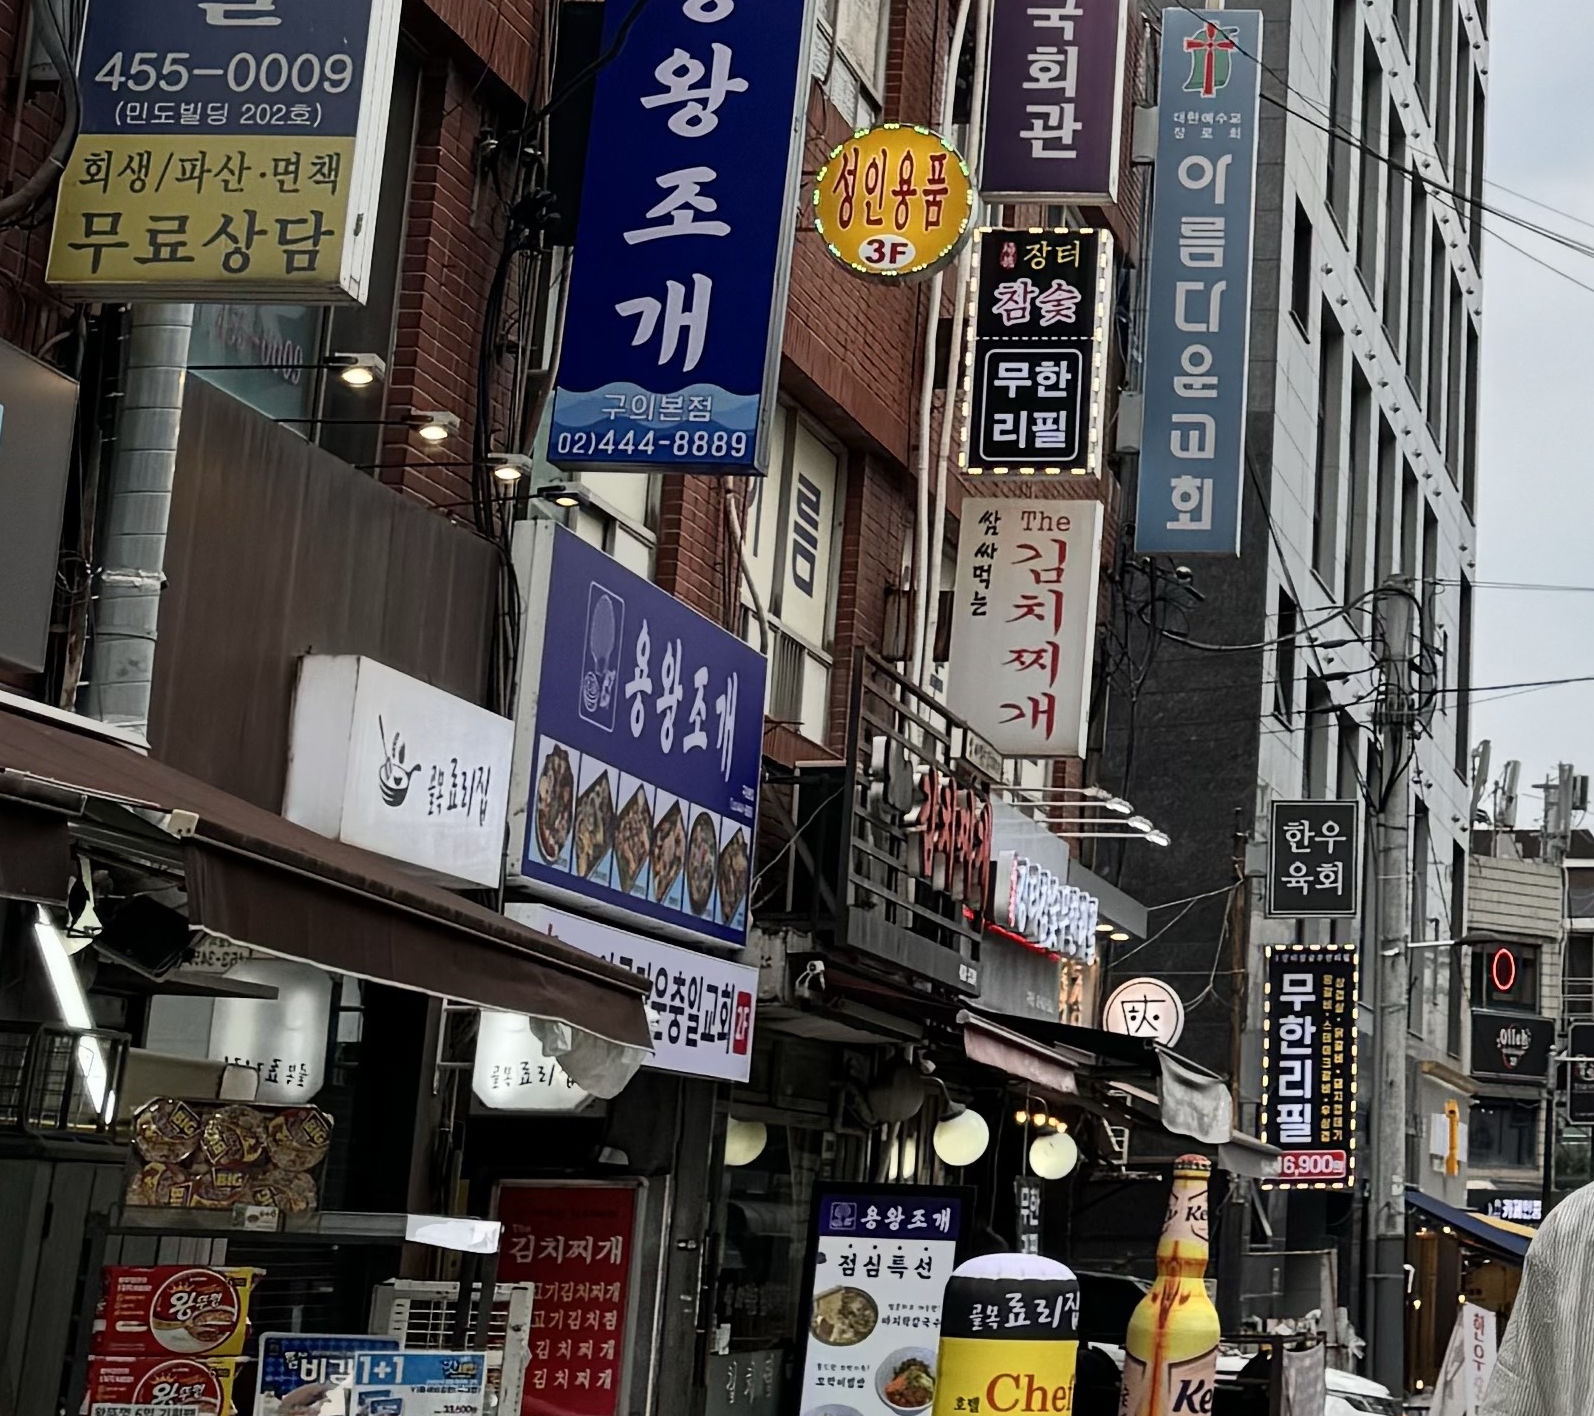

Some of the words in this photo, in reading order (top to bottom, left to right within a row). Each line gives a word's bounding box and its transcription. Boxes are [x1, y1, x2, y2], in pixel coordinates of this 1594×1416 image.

[95, 52, 353, 95] 455-0009
[115, 101, 229, 126] (민도빌딩
[240, 101, 321, 127] 202호)
[1174, 112, 1242, 126] 대한예수교
[79, 150, 342, 195] 회생/파산·면책
[833, 147, 949, 231] 성인용품
[67, 210, 334, 275] 무료상담
[865, 239, 909, 264] 3F
[1025, 240, 1080, 270] 장터
[992, 278, 1082, 326] 참숯
[1166, 154, 1234, 531] 아름다운교회
[994, 361, 1071, 398] 무한
[602, 394, 713, 422] 구의본점
[557, 430, 747, 458] 02)444-8889
[993, 411, 1067, 449] 리필
[1021, 510, 1071, 531] The
[998, 539, 1067, 740] 김치찌개
[624, 618, 738, 782] 용왕조개
[1282, 820, 1347, 854] 한우
[1281, 861, 1343, 896] 육회
[1276, 973, 1316, 1144] 무한리필
[860, 1205, 951, 1233] 용왕조개
[508, 1235, 623, 1265] 김치찌개
[837, 1252, 933, 1279] 점심특선
[535, 1339, 615, 1360] 김치찌개
[359, 1356, 405, 1384] 1+1
[532, 1368, 613, 1390] 김치찌개
[953, 1396, 979, 1414] 호텔
